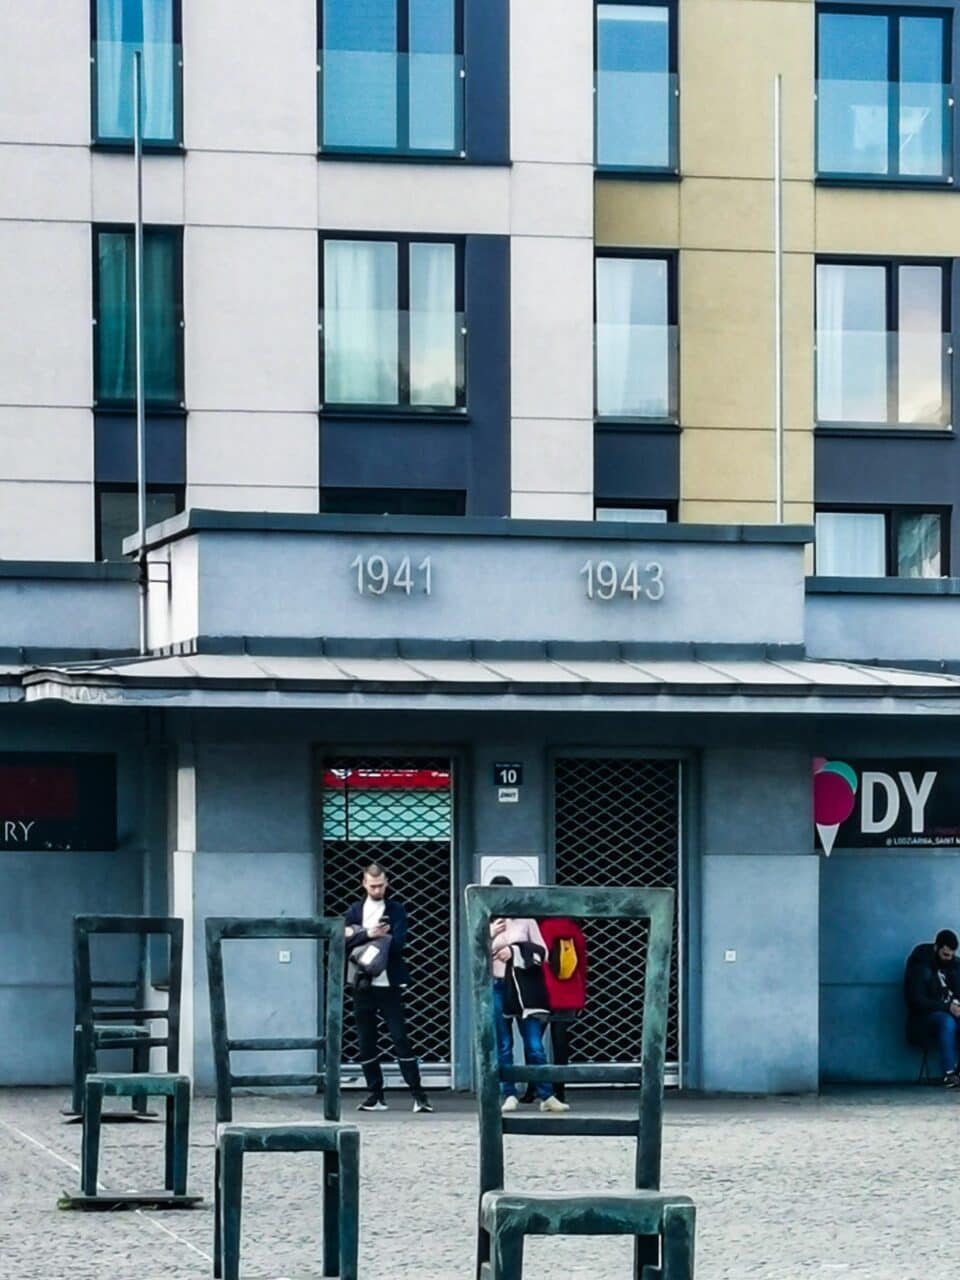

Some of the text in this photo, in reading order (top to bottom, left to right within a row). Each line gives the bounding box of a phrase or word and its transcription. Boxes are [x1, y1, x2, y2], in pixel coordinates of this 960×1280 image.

[351, 554, 432, 596] 1941
[579, 559, 666, 601] 1943
[500, 769, 517, 784] 10
[860, 771, 938, 833] DY
